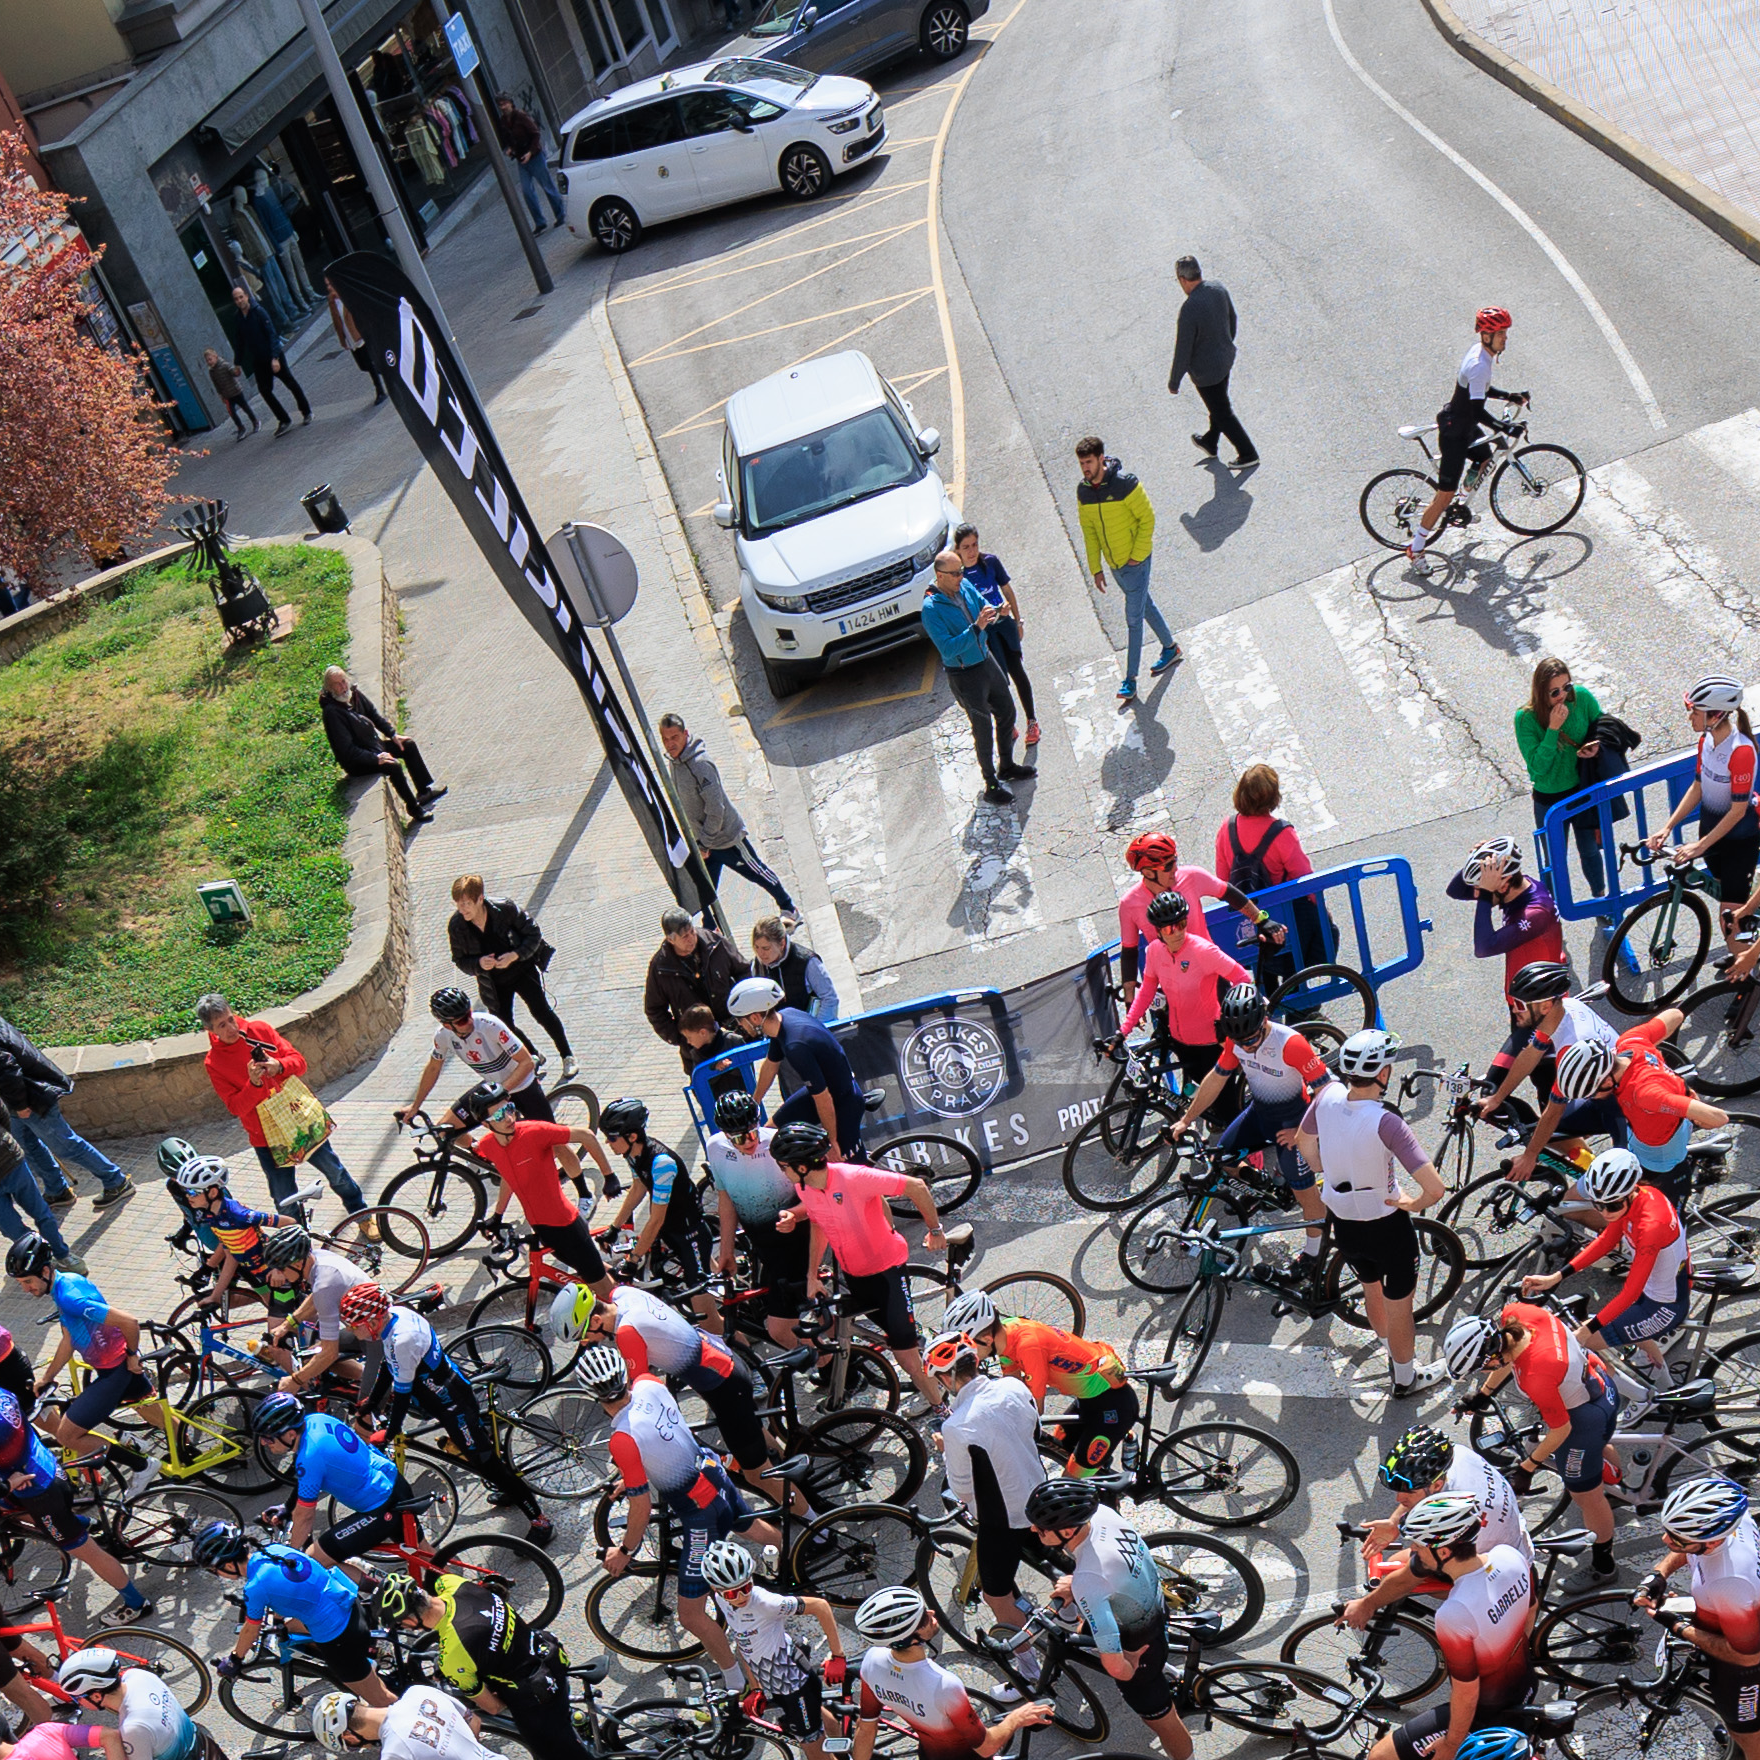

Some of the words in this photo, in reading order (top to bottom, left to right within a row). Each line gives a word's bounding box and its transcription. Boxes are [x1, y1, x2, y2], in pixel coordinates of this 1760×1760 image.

[453, 31, 472, 59] TAXI
[808, 574, 851, 590] RANGE
[861, 553, 905, 571] ROVER
[847, 610, 877, 631] 1424
[878, 603, 901, 620] HMW
[912, 1025, 989, 1068] FERBIKES
[929, 1076, 994, 1109] PRATS
[1445, 1080, 1463, 1094] 138
[1487, 1573, 1530, 1624] GARRELLS
[874, 1684, 926, 1718] GARRELLS
